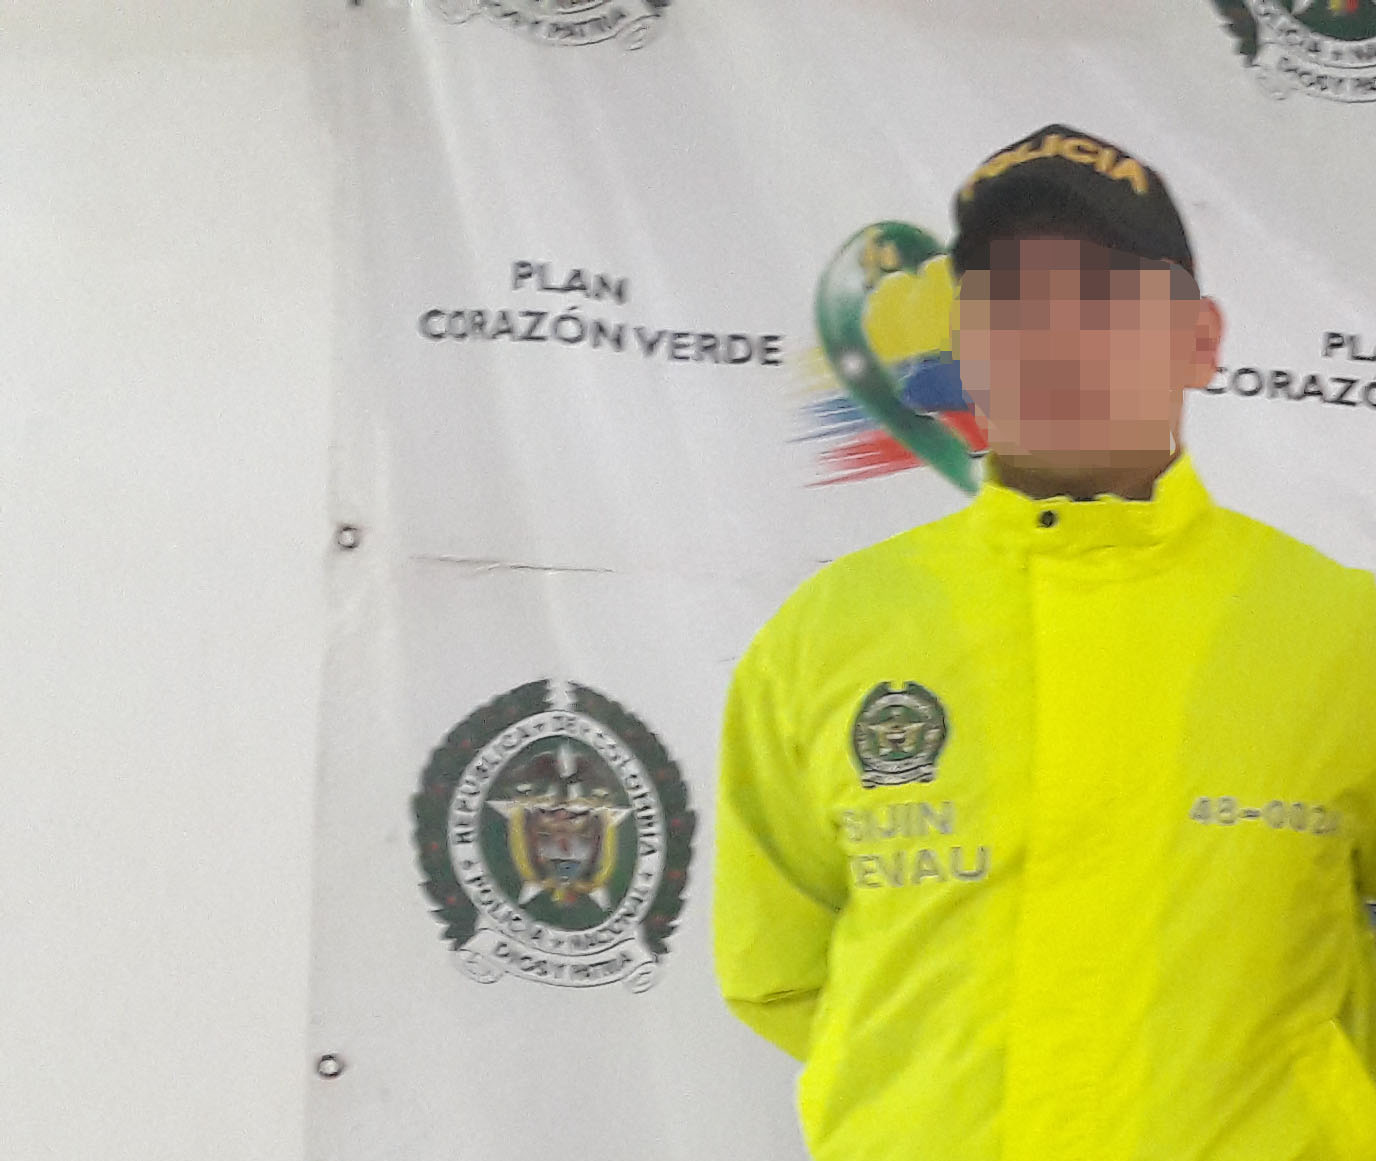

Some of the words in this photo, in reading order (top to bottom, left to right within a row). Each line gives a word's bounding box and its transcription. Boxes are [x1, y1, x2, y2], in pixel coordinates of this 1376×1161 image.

[511, 260, 631, 305] PLAN
[417, 305, 624, 352] CORAZÓN
[634, 326, 784, 367] VERDE
[850, 846, 991, 889] EVAU
